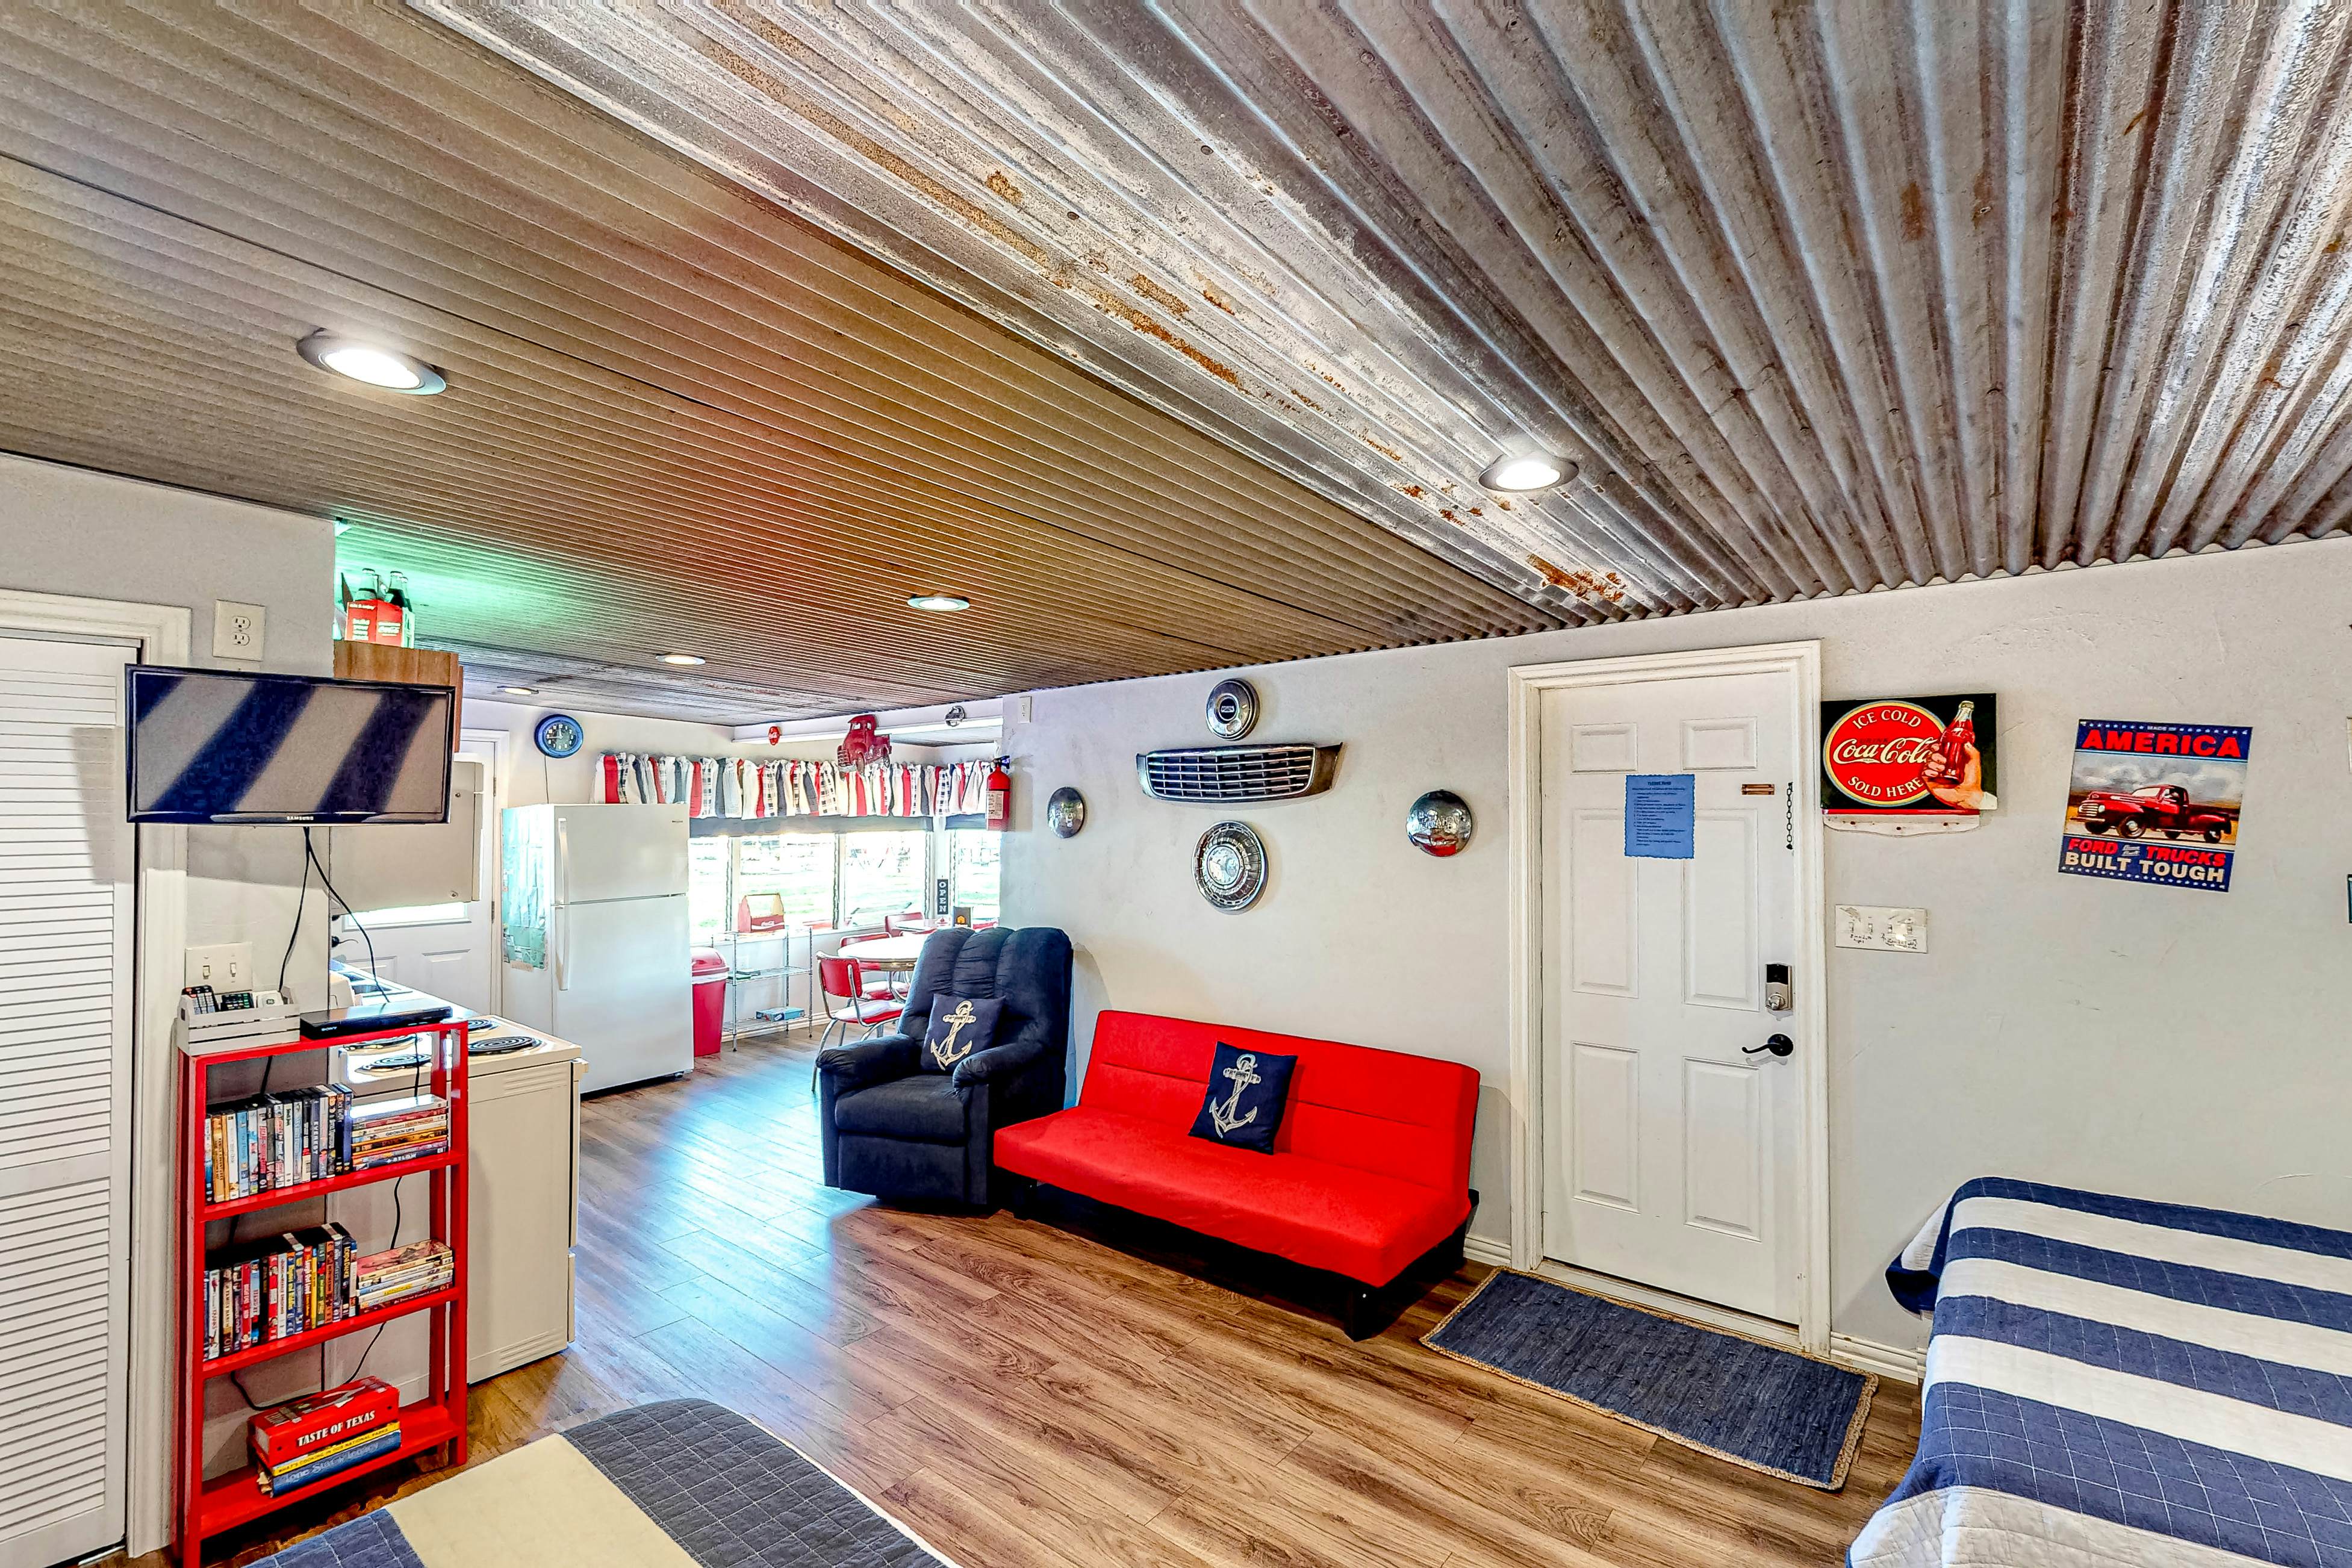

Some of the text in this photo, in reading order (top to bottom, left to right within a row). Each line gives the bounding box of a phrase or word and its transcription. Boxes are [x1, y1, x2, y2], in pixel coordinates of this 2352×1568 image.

[1852, 710, 1921, 729] ICE COLD
[2082, 729, 2241, 758] AMERICA
[1848, 776, 1924, 797] SOLD HERE
[2065, 851, 2225, 883] BUILT TOUGH
[2068, 838, 2118, 854] FORD
[2146, 846, 2226, 867] TRUCKS
[297, 1410, 375, 1446] TASTE OF TEXAS
